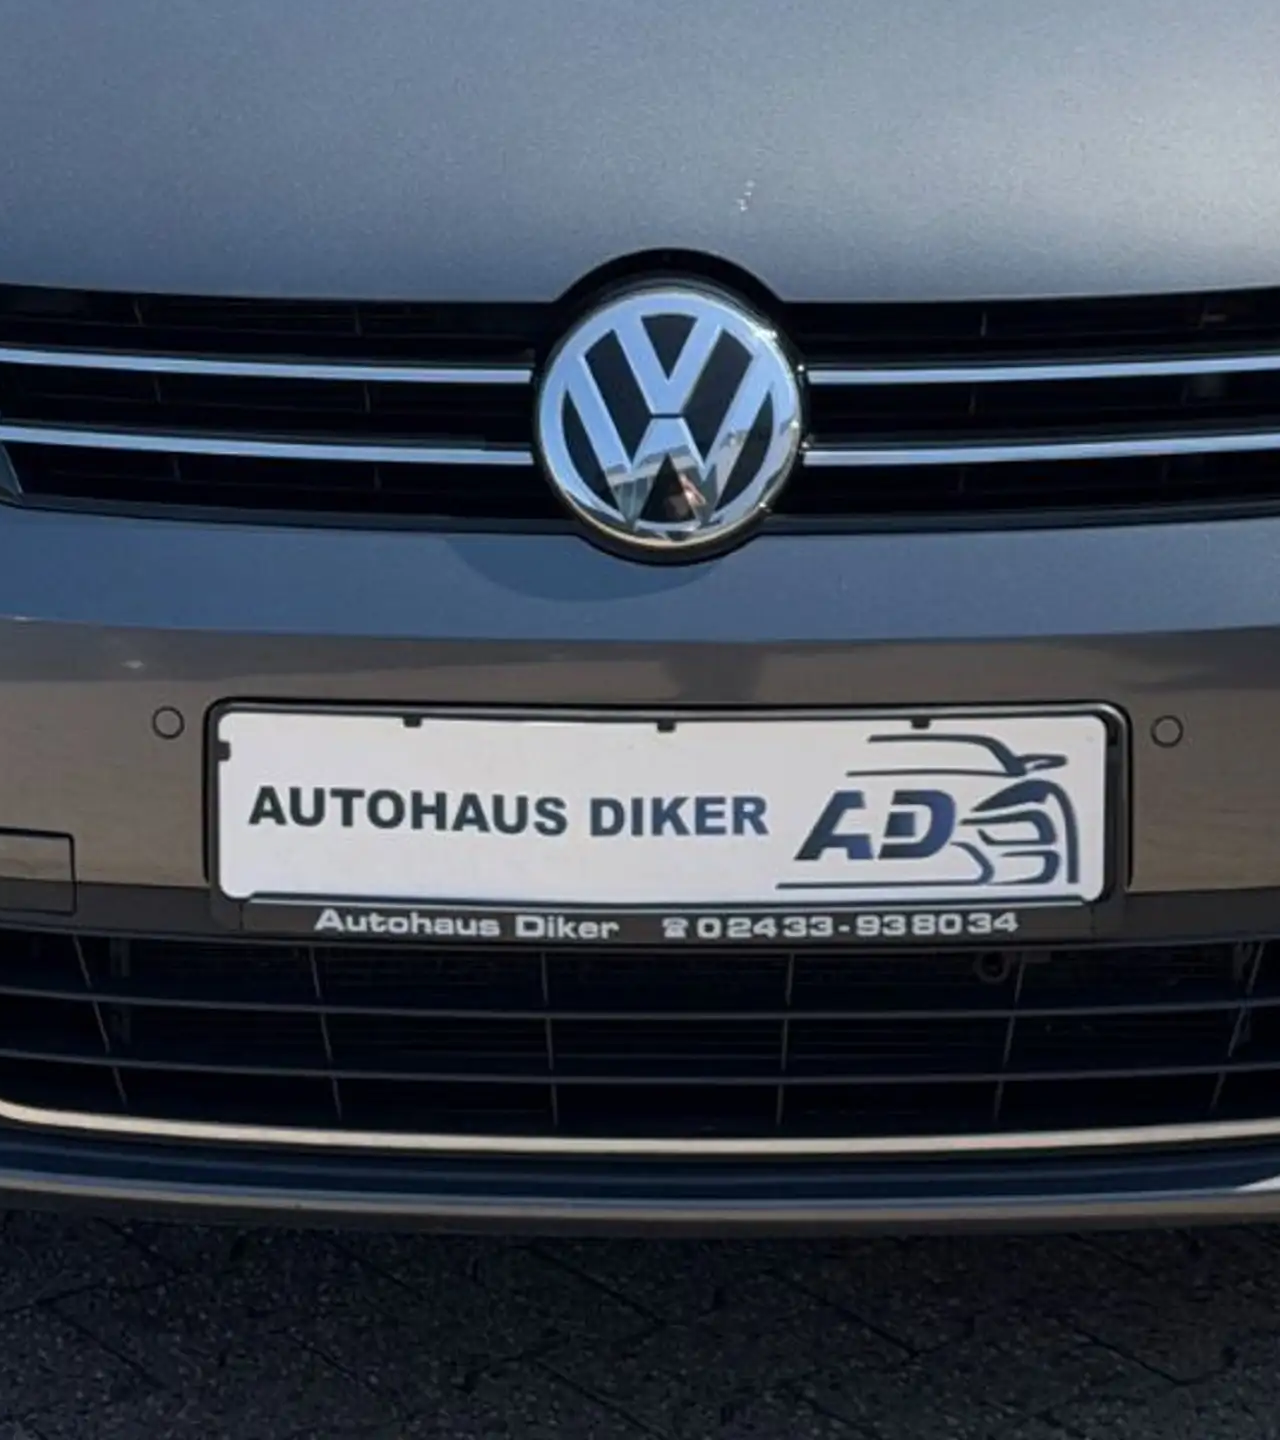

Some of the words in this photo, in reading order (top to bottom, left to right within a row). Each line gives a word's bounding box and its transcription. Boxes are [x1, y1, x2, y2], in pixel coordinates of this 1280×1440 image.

[542, 295, 799, 544] VW
[248, 785, 568, 836] AUTOHAUS
[589, 795, 770, 837] DIKER
[793, 789, 956, 861] AD
[314, 908, 500, 937] Autohaus
[514, 914, 620, 939] Diker
